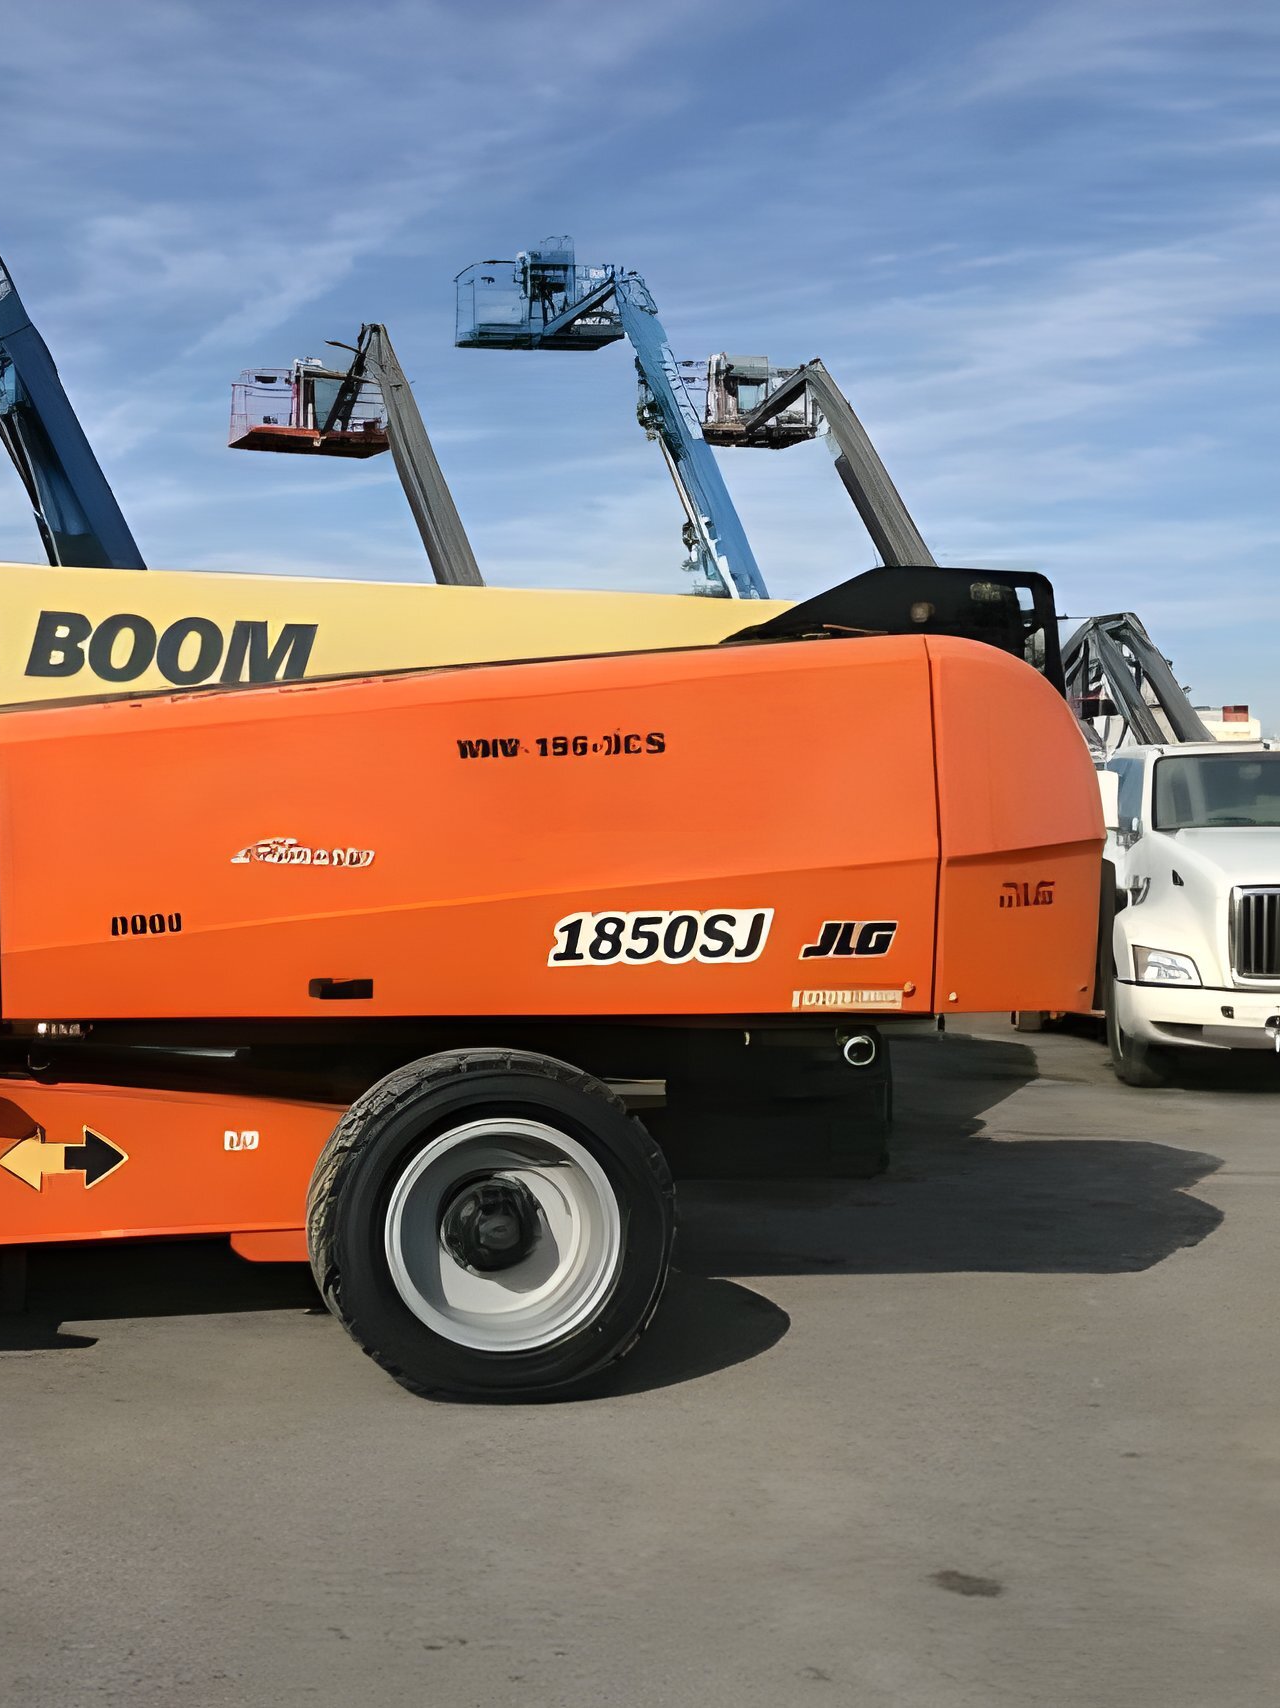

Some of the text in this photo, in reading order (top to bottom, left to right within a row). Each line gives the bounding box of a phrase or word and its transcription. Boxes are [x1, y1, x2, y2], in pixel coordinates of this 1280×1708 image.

[24, 610, 318, 684] BOOM
[552, 911, 766, 962] 1850SJ
[802, 922, 898, 958] JLG
